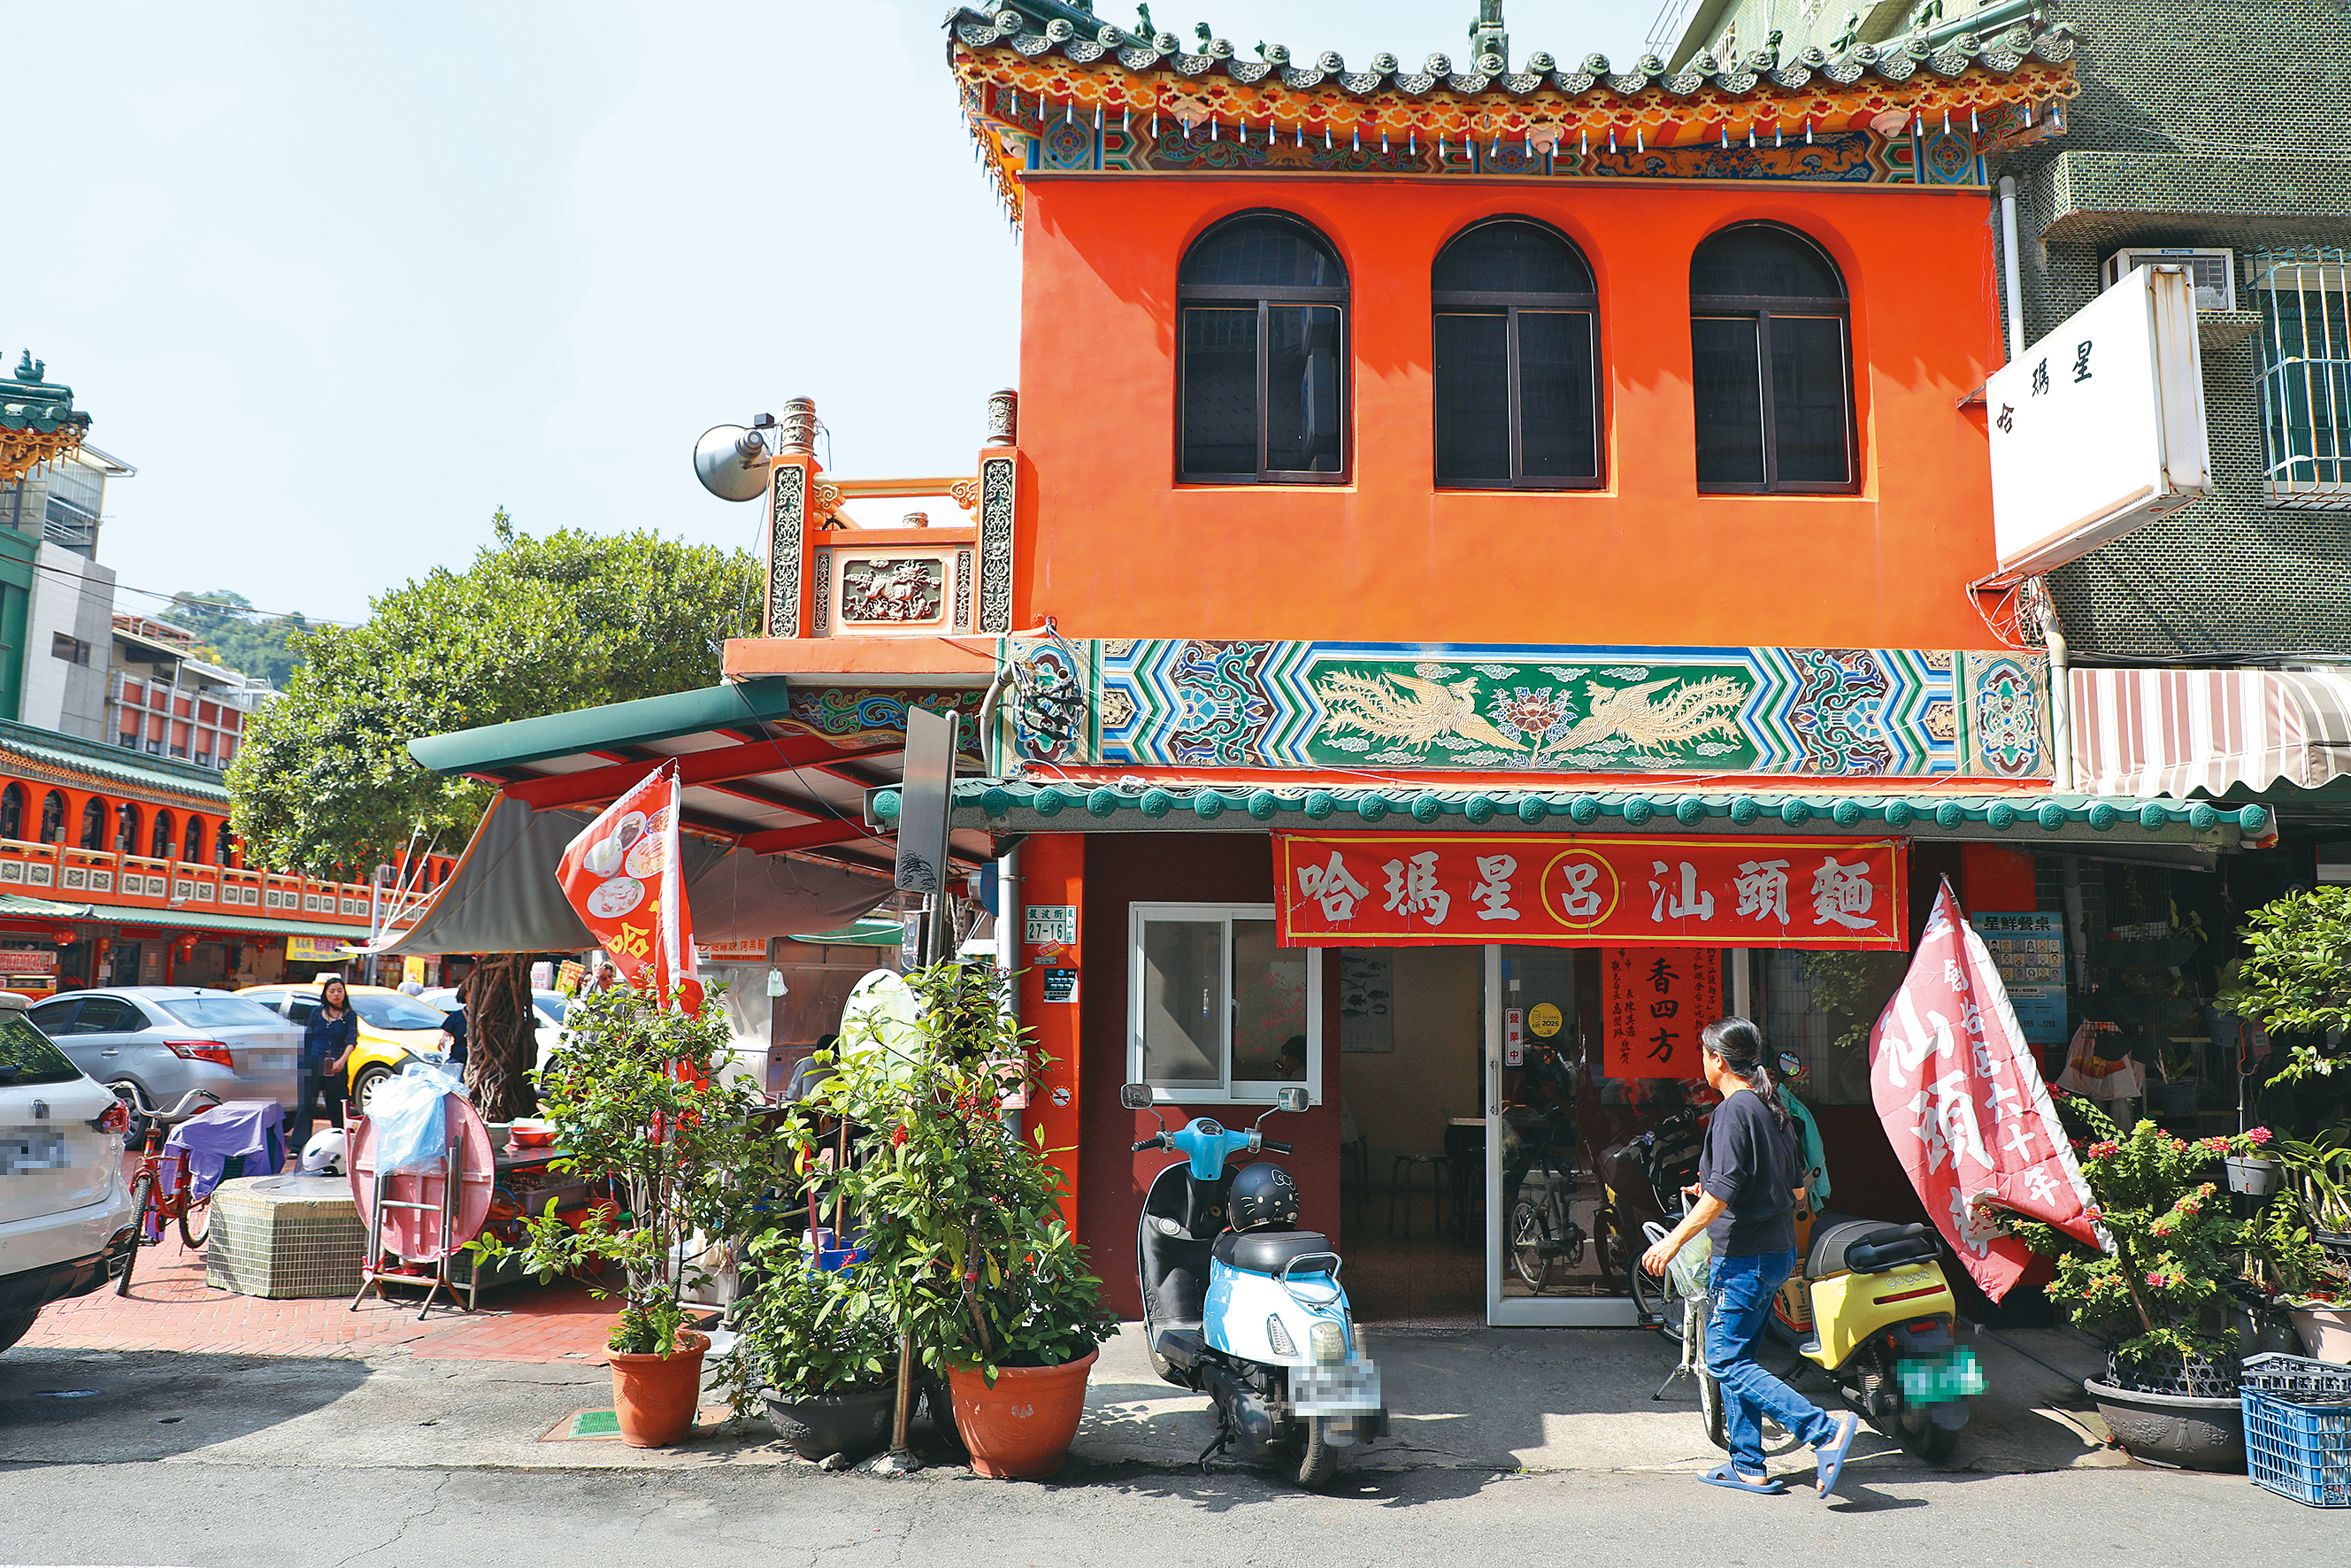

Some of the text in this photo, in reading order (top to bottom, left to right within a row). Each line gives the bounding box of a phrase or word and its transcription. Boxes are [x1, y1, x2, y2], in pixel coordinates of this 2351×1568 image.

[1996, 340, 2093, 434] 哈瑪星
[1028, 908, 1064, 919] 鼓波街
[1028, 922, 1063, 940] 27-16
[1984, 916, 2051, 931] 星鮮餐桌
[1646, 947, 1680, 1064] 香四方
[1510, 1013, 1519, 1060] 營業中
[1886, 1271, 1931, 1290] gogoro
